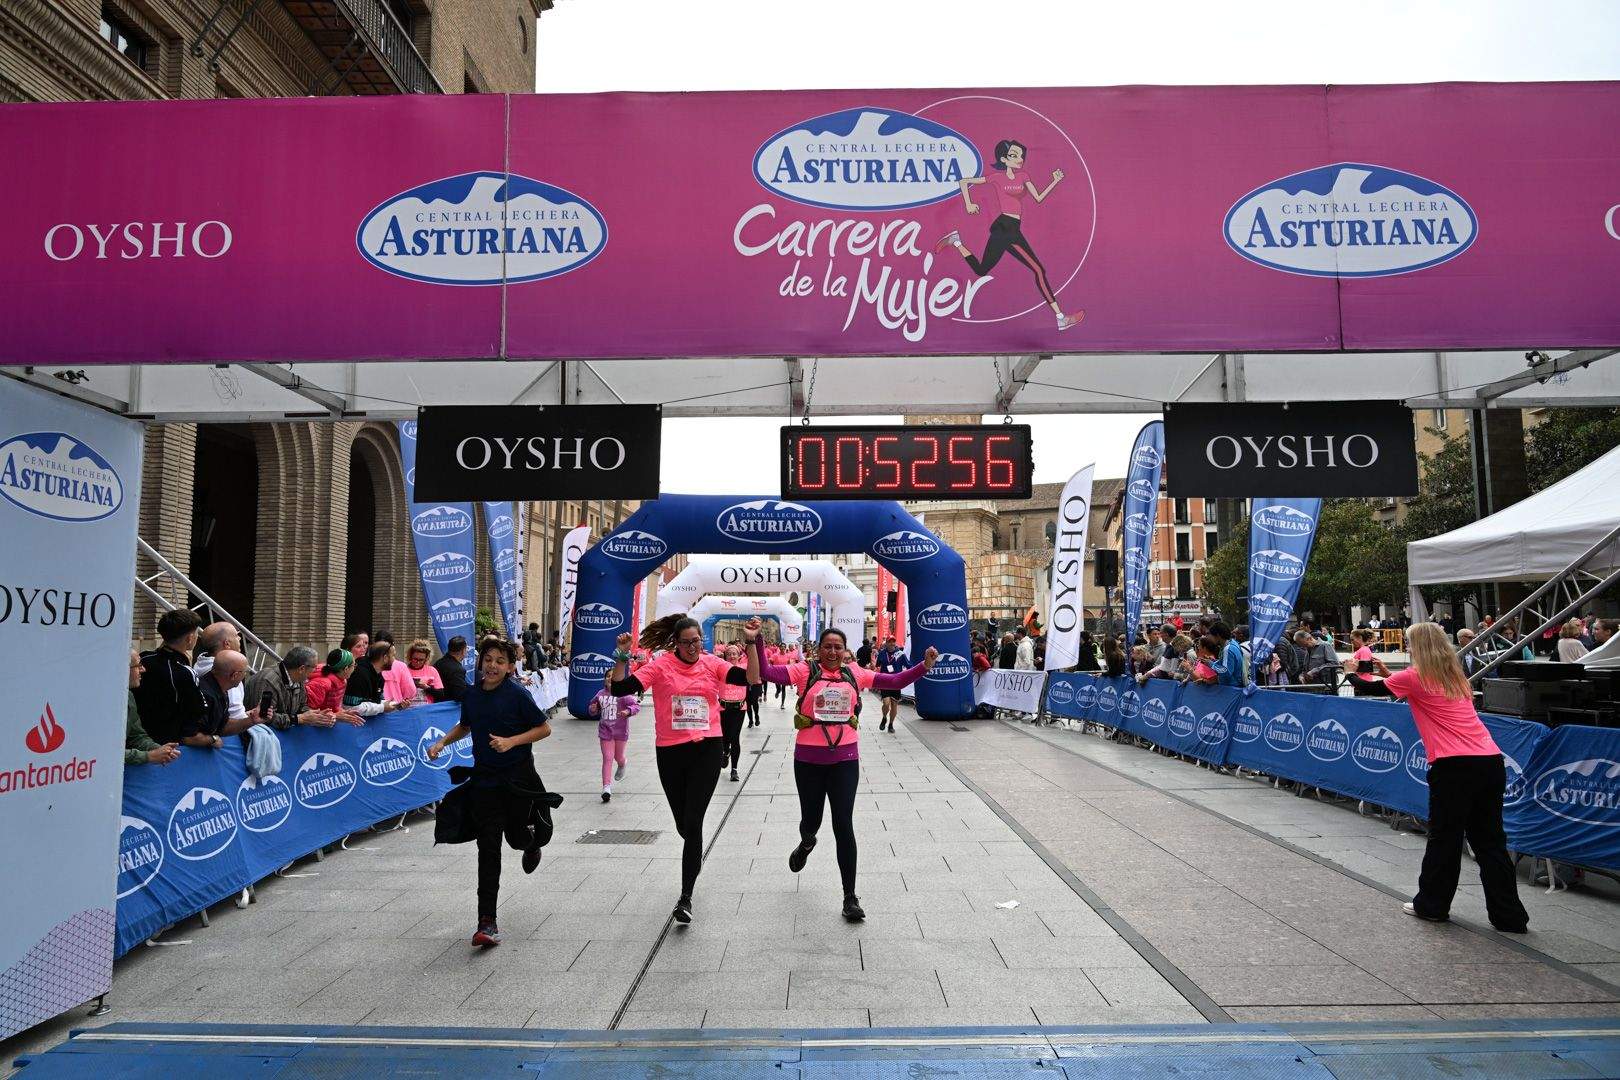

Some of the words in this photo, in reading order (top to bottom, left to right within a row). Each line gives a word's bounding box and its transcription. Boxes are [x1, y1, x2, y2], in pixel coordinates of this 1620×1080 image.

[806, 143, 877, 153] CENTRAL
[884, 142, 958, 152] LECHERA
[771, 145, 963, 184] ASTURIANA
[415, 210, 493, 223] CENTRAL
[501, 210, 581, 221] LECHERA
[1281, 203, 1360, 214] CENTRAL
[1368, 201, 1449, 212] LECHERA
[375, 215, 588, 257] ASTURIANA
[733, 203, 922, 258] Carrera
[1244, 207, 1459, 248] ASTURIANA
[44, 220, 234, 261] OYSHO
[779, 260, 814, 297] de
[823, 259, 848, 298] la
[842, 252, 994, 342] Mujer
[456, 436, 626, 471] OYSHO
[1206, 434, 1379, 469] OYSHO
[0, 452, 114, 506] ASTURIANA
[23, 454, 68, 473] CENTRAL
[71, 466, 112, 482] LECHERA
[725, 512, 814, 534] ASTURIANA
[1259, 513, 1311, 532] ASTURIANA
[605, 541, 661, 554] ASTURIANA
[879, 544, 935, 554] ASTURIANA
[720, 566, 802, 584] OYSHO
[1053, 495, 1087, 633] OYSHO
[824, 583, 849, 591] OYSHO
[577, 612, 620, 625] ASTURIANA
[838, 617, 861, 625] OYSHO
[921, 614, 966, 625] ASTURIANA
[572, 661, 614, 674] ASTURIAN
[926, 663, 968, 675] STURIANA
[995, 673, 1032, 693] OYSHO
[1236, 722, 1259, 736] TURIANA
[1268, 725, 1300, 744] ASTURIANA
[1309, 733, 1345, 753] ASTURIANA
[1355, 742, 1398, 764] ASTURIANA
[0, 756, 96, 793] antander
[366, 755, 412, 779] ASTURIANA
[300, 771, 354, 800] ASTURIANA
[242, 793, 290, 822] ASTURIANA
[175, 811, 236, 850] ASTURIANA
